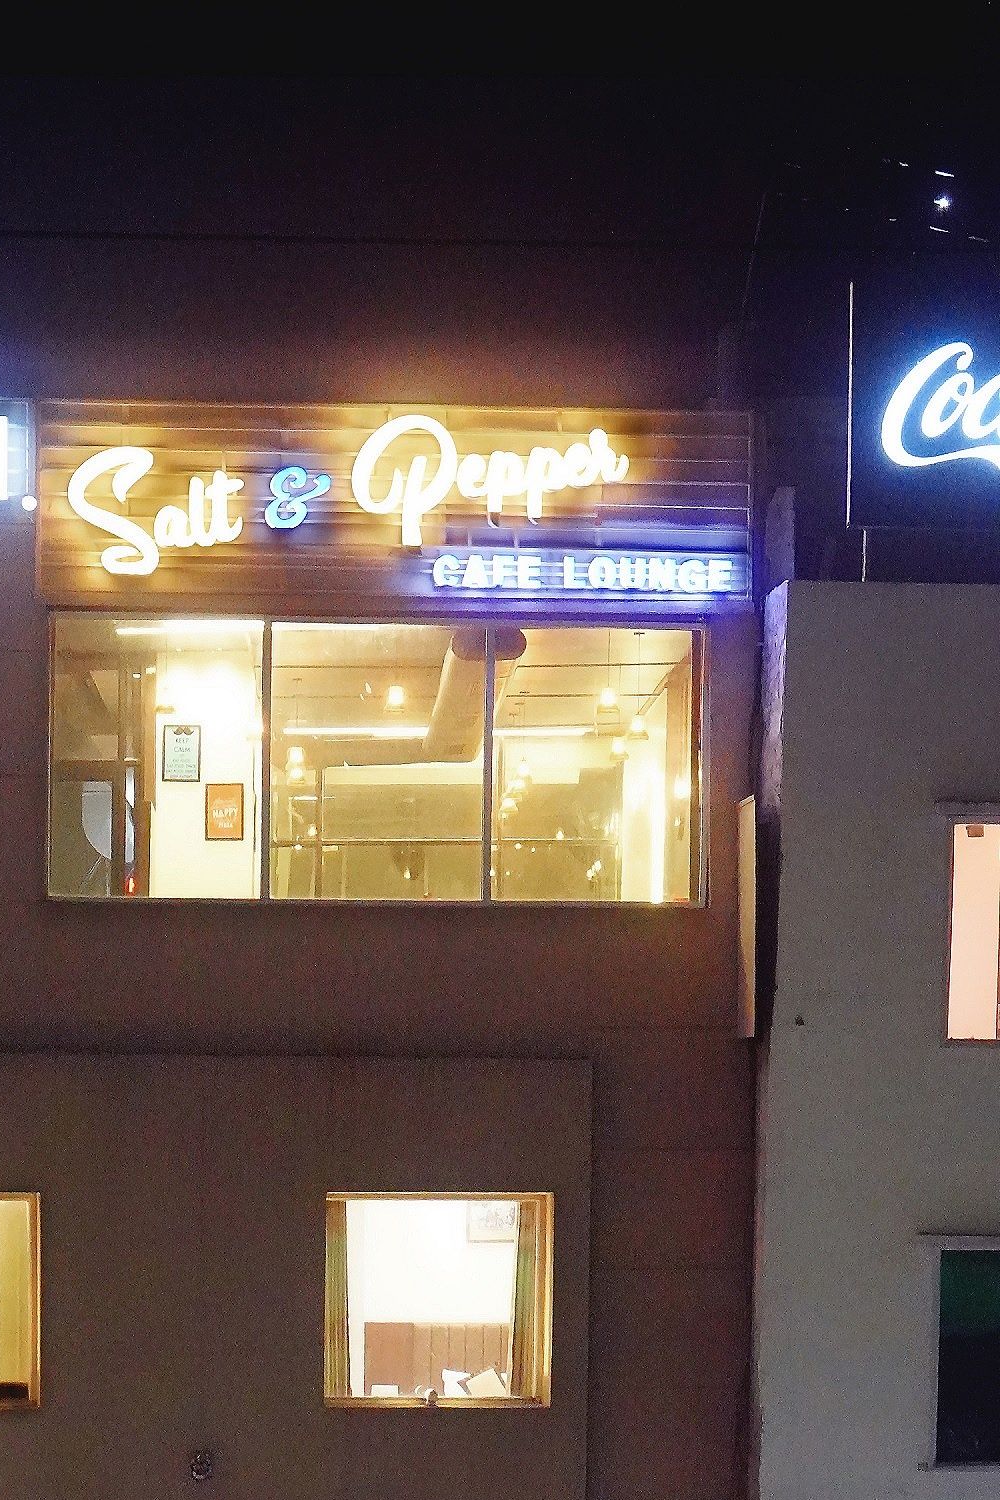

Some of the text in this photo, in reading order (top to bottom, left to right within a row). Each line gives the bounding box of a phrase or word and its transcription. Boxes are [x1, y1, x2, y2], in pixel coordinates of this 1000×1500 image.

[67, 414, 630, 575] Salt & Pepper
[432, 554, 733, 594] CAFE LOUNGE
